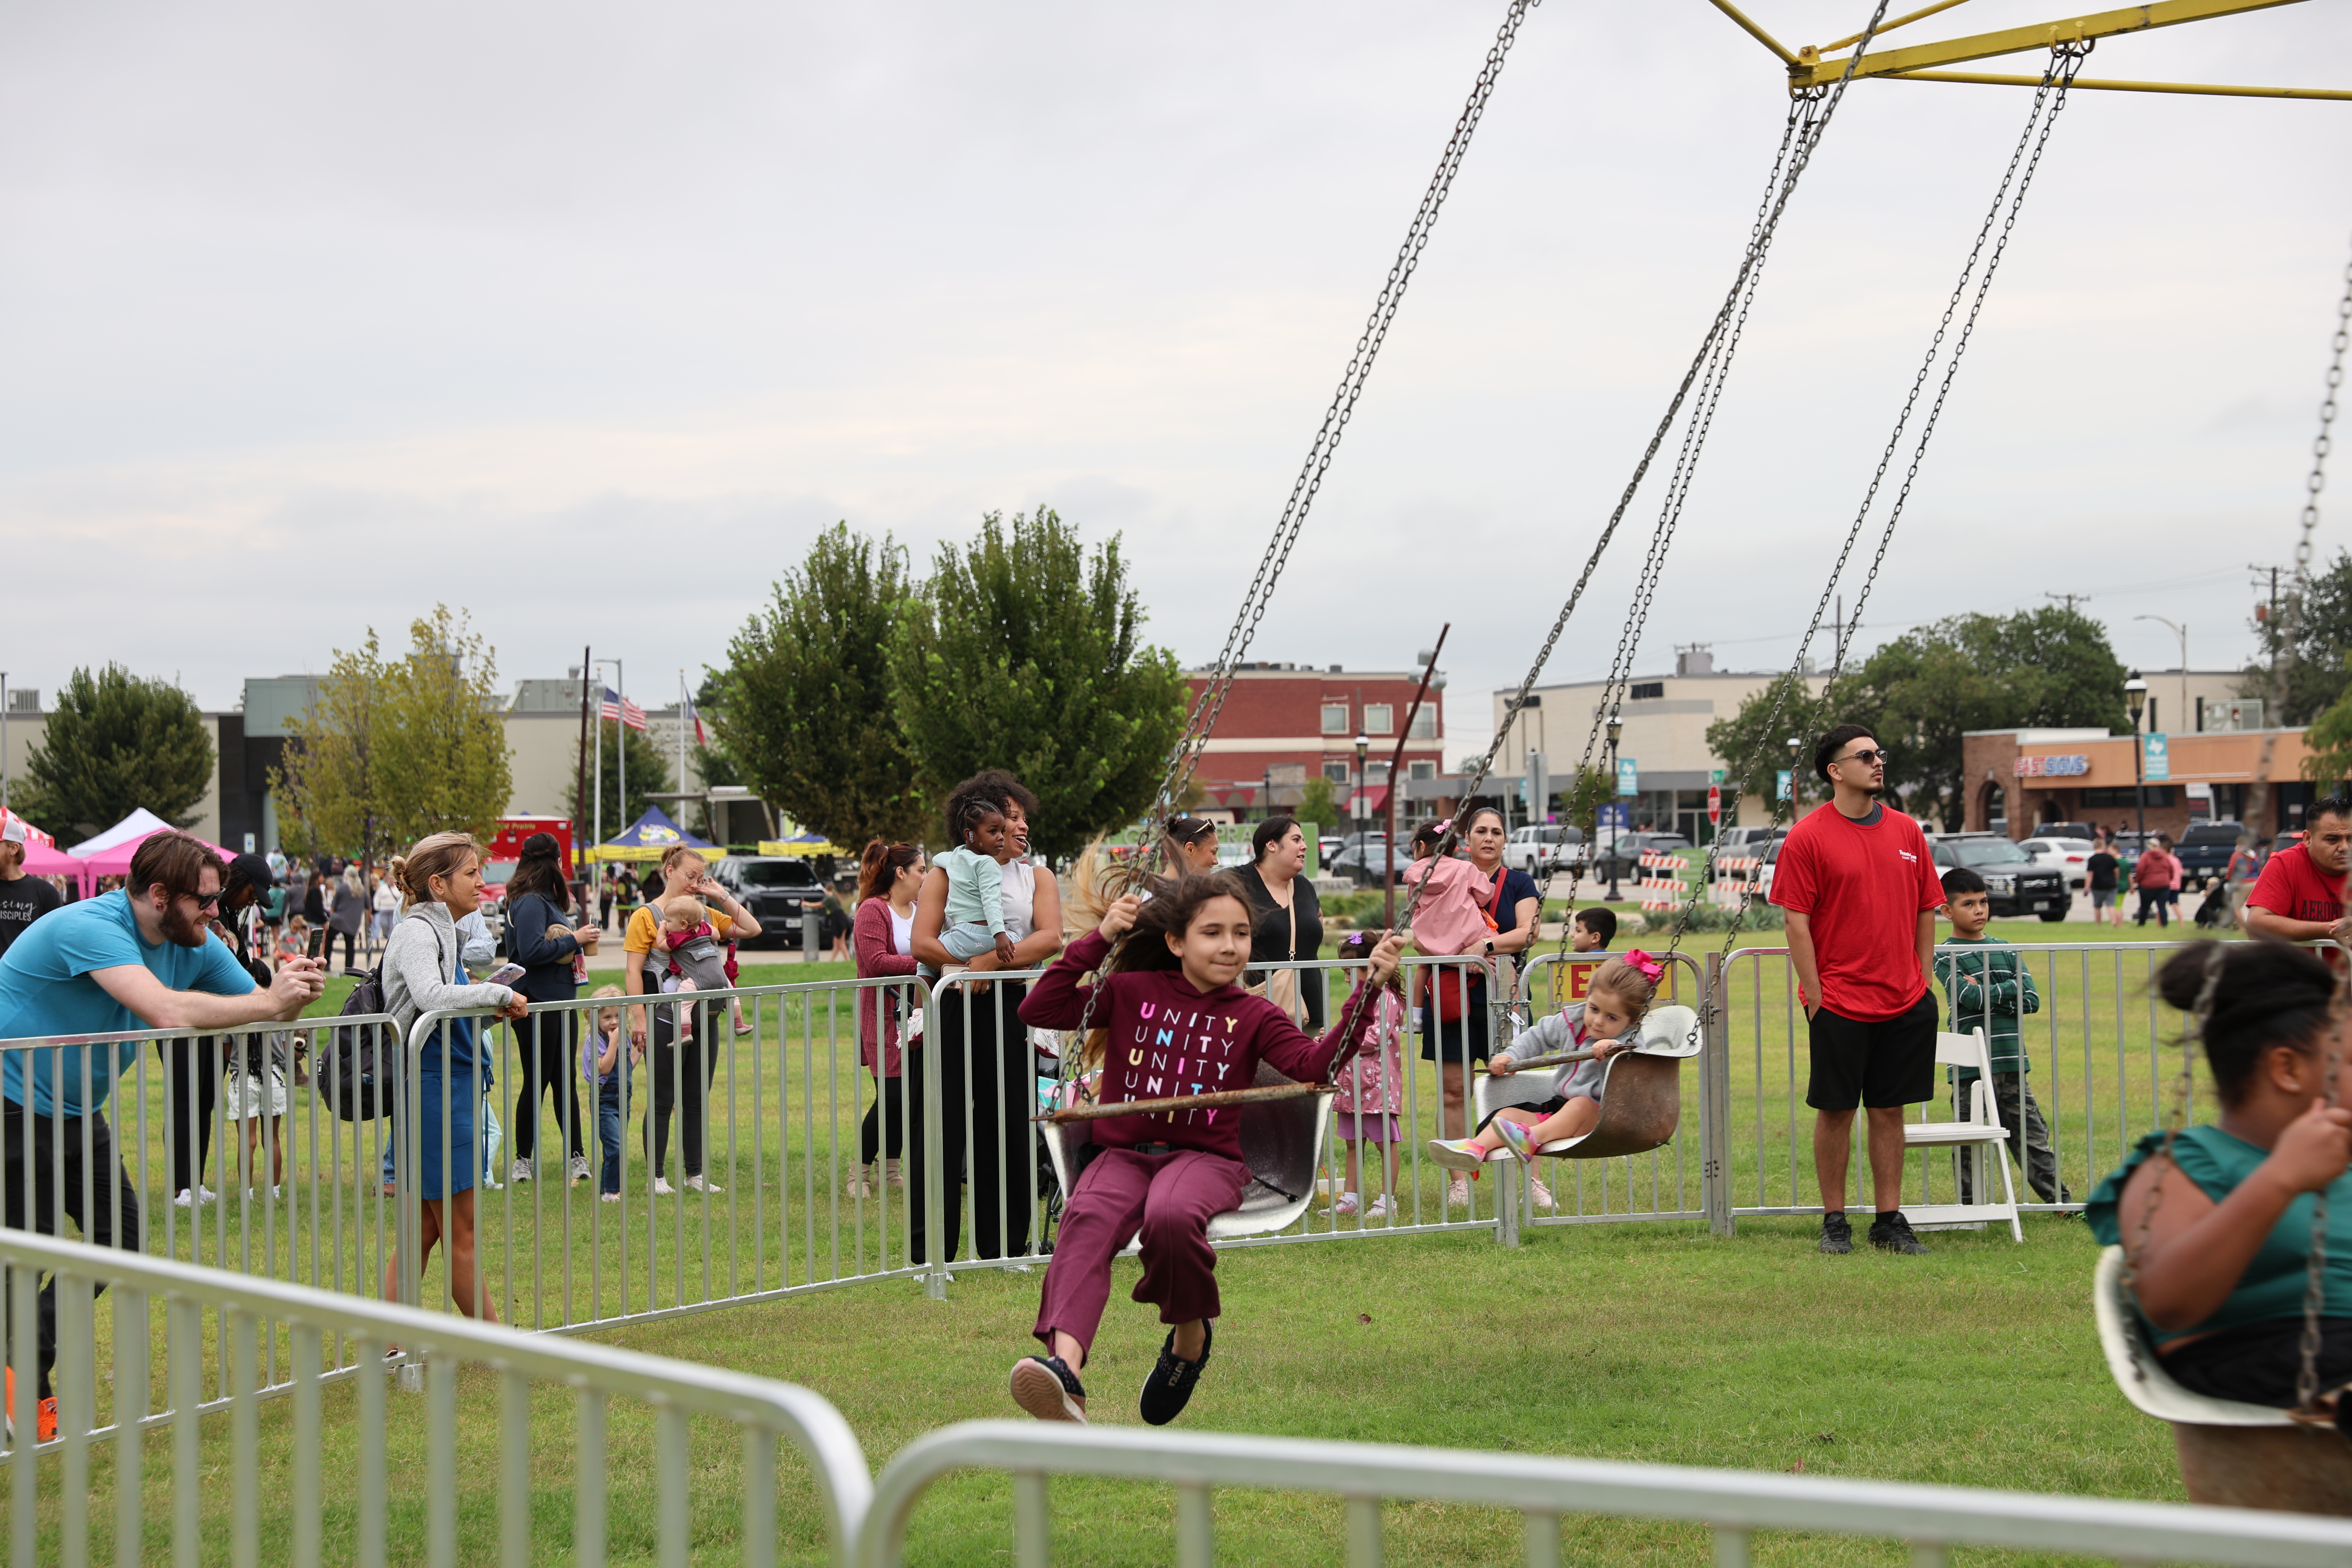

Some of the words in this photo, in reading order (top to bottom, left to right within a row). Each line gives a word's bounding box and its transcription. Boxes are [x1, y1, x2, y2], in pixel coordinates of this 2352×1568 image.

[2013, 754, 2088, 777] FASTSIGNS
[1708, 797, 1720, 813] STOP
[1602, 814, 1624, 823] VISON
[0, 899, 37, 915] sing
[0, 910, 32, 922] ISCIPLES
[2300, 900, 2343, 922] AEROPO
[1140, 1002, 1238, 1033] UNITY
[1135, 1025, 1234, 1056] UNITY
[1129, 1048, 1230, 1080] UNITY
[1168, 1360, 1187, 1386] NAUTICA
